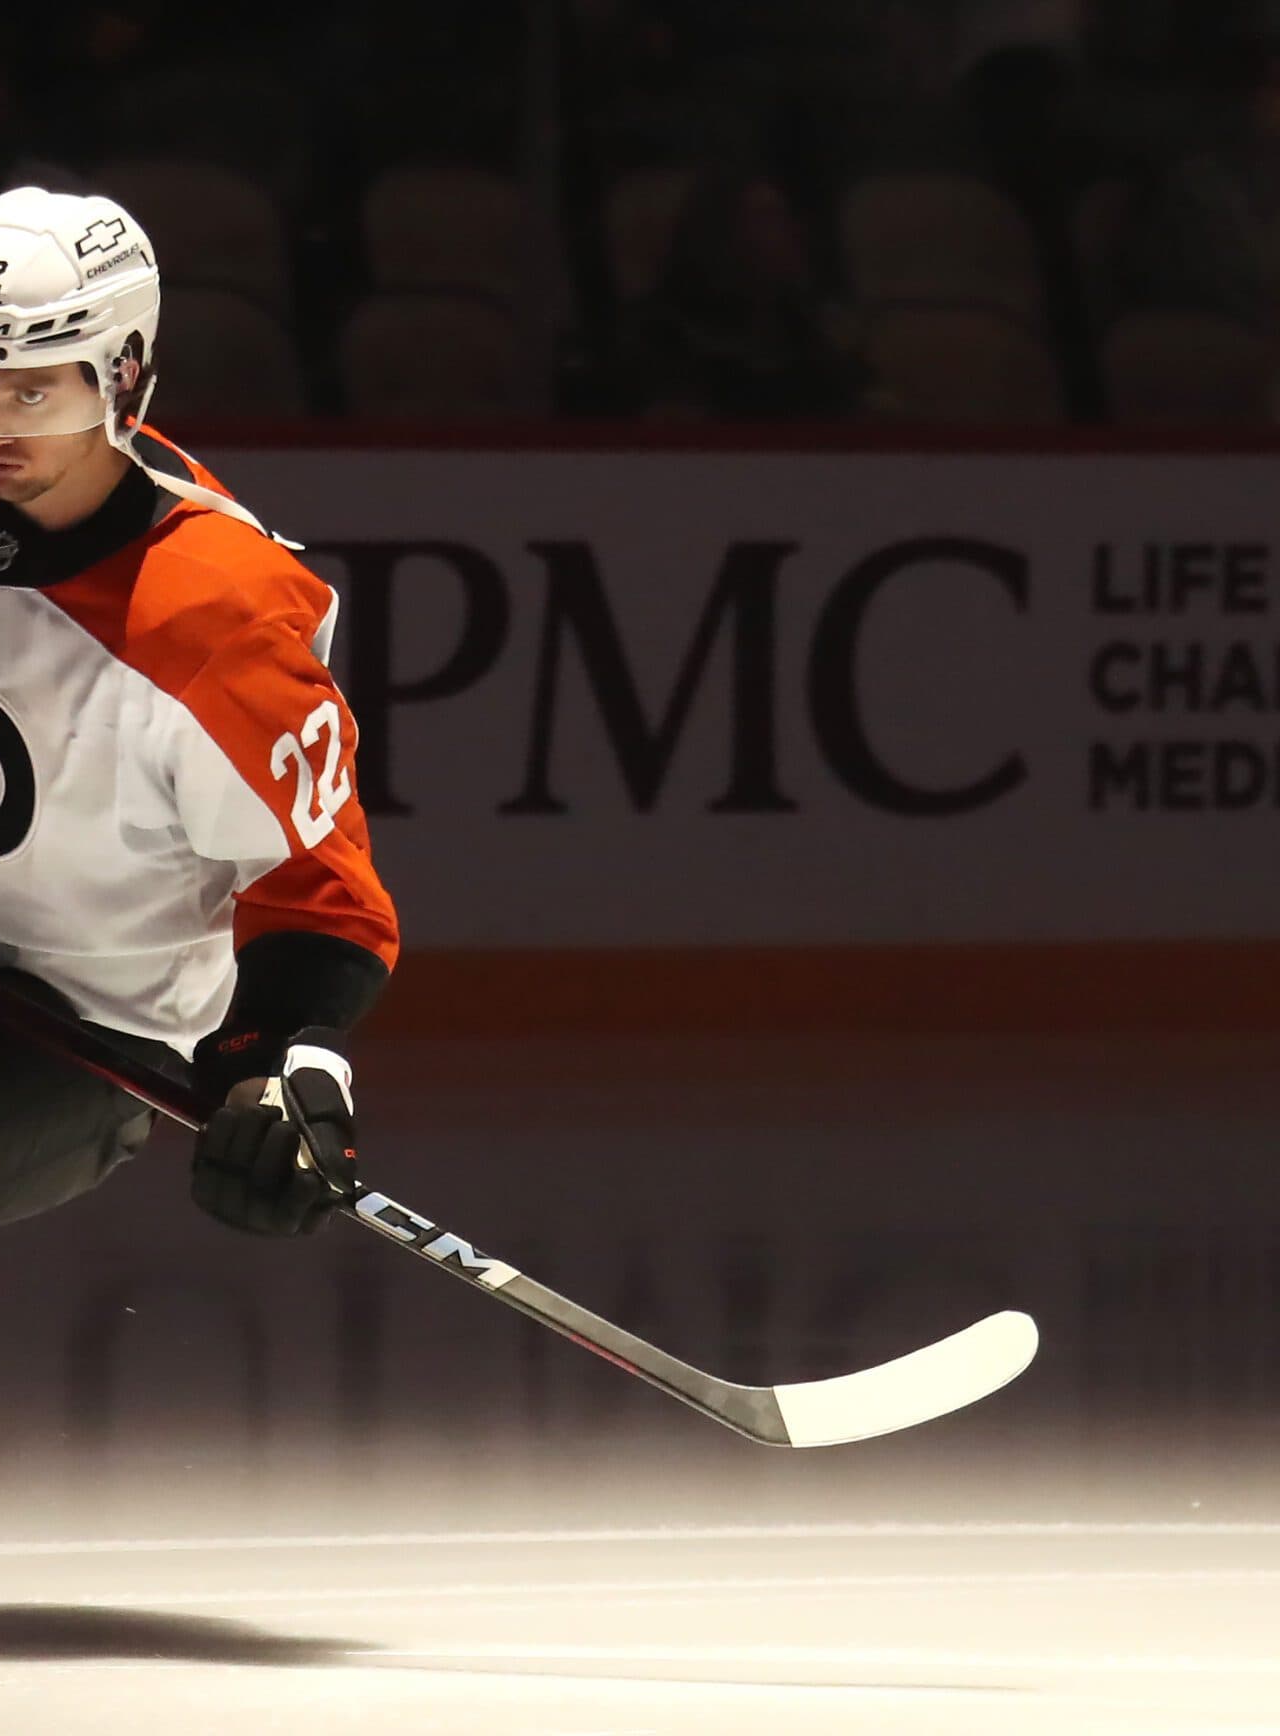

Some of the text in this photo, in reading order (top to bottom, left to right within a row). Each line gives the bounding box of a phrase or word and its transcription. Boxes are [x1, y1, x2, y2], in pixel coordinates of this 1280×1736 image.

[1093, 544, 1269, 613] LIFE
[1090, 643, 1280, 713] CHA
[271, 700, 352, 850] 22
[354, 1179, 521, 1290] CM
